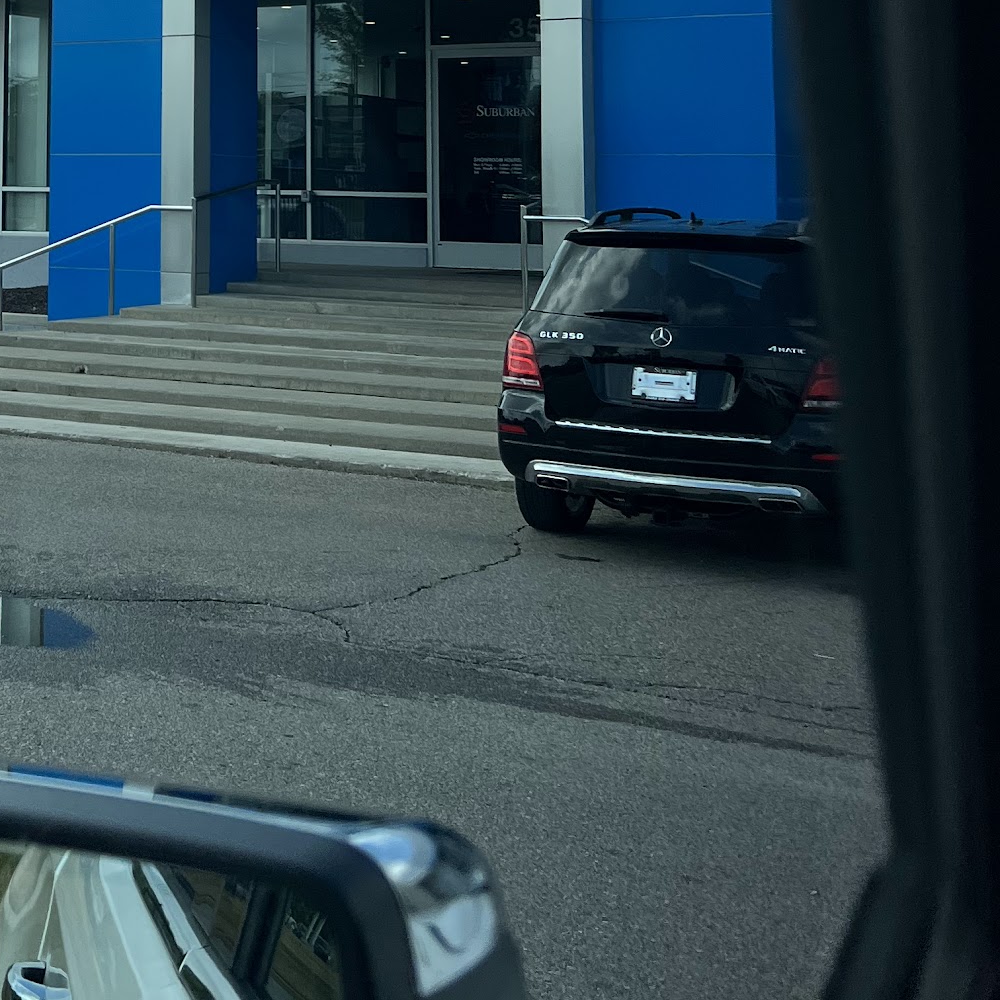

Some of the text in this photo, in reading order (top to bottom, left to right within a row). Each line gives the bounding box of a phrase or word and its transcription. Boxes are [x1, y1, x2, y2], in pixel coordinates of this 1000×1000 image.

[475, 104, 536, 118] SUBURBAN
[539, 330, 585, 340] GLK 350
